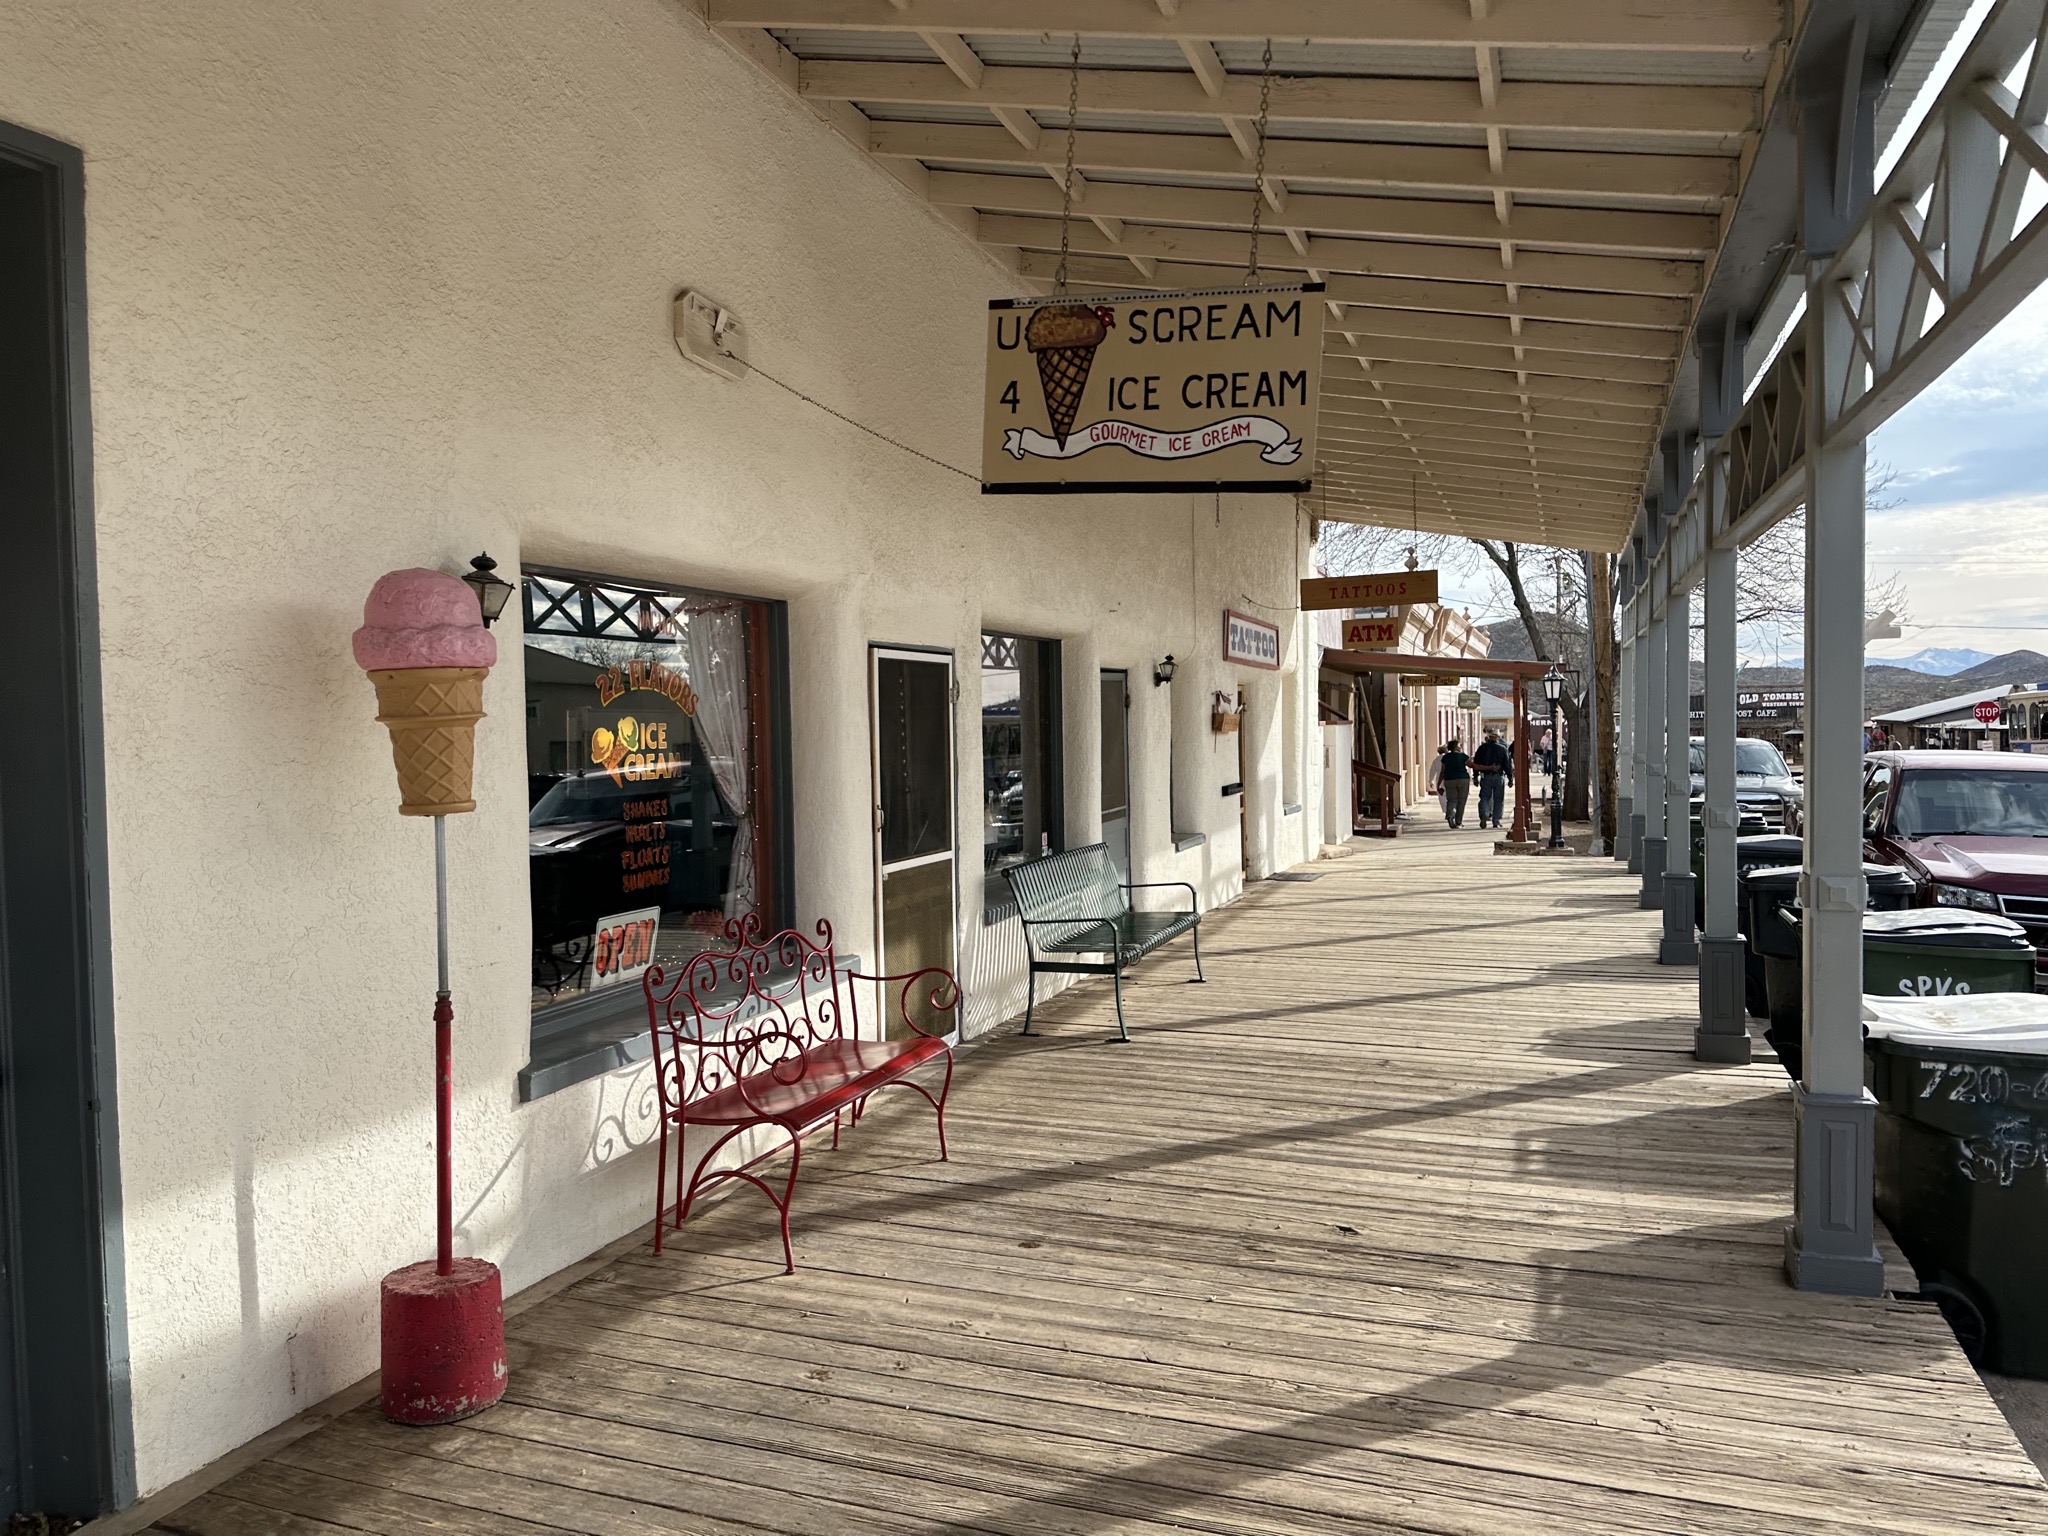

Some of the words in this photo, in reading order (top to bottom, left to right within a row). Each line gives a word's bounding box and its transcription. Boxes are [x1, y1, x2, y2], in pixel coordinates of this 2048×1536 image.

[997, 315, 1021, 350] U
[1128, 301, 1301, 345] SCREAM
[1000, 380, 1020, 414] 4
[1108, 376, 1160, 411] ICE
[1181, 370, 1307, 409] CREAM
[1090, 424, 1157, 451] GOURMET
[1168, 435, 1192, 452] ICE
[1202, 423, 1251, 448] CREAM
[1329, 582, 1407, 600] TATTOOS
[1230, 623, 1275, 659] TATTOO
[1347, 624, 1394, 642] ATM
[596, 667, 625, 707] 22
[628, 658, 698, 717] FLAVORS
[1739, 694, 1759, 705] OLD
[1762, 692, 1804, 701] TOMBST
[1756, 709, 1777, 717] CAFE
[1975, 707, 1999, 717] STOP
[640, 723, 667, 749] ICE
[624, 753, 682, 781] CREAM
[623, 799, 667, 820] SHAKES
[625, 822, 666, 843] MALTS
[621, 845, 670, 869] FLOATS
[596, 918, 656, 977] OPEN
[1959, 1136, 2048, 1187] SP
